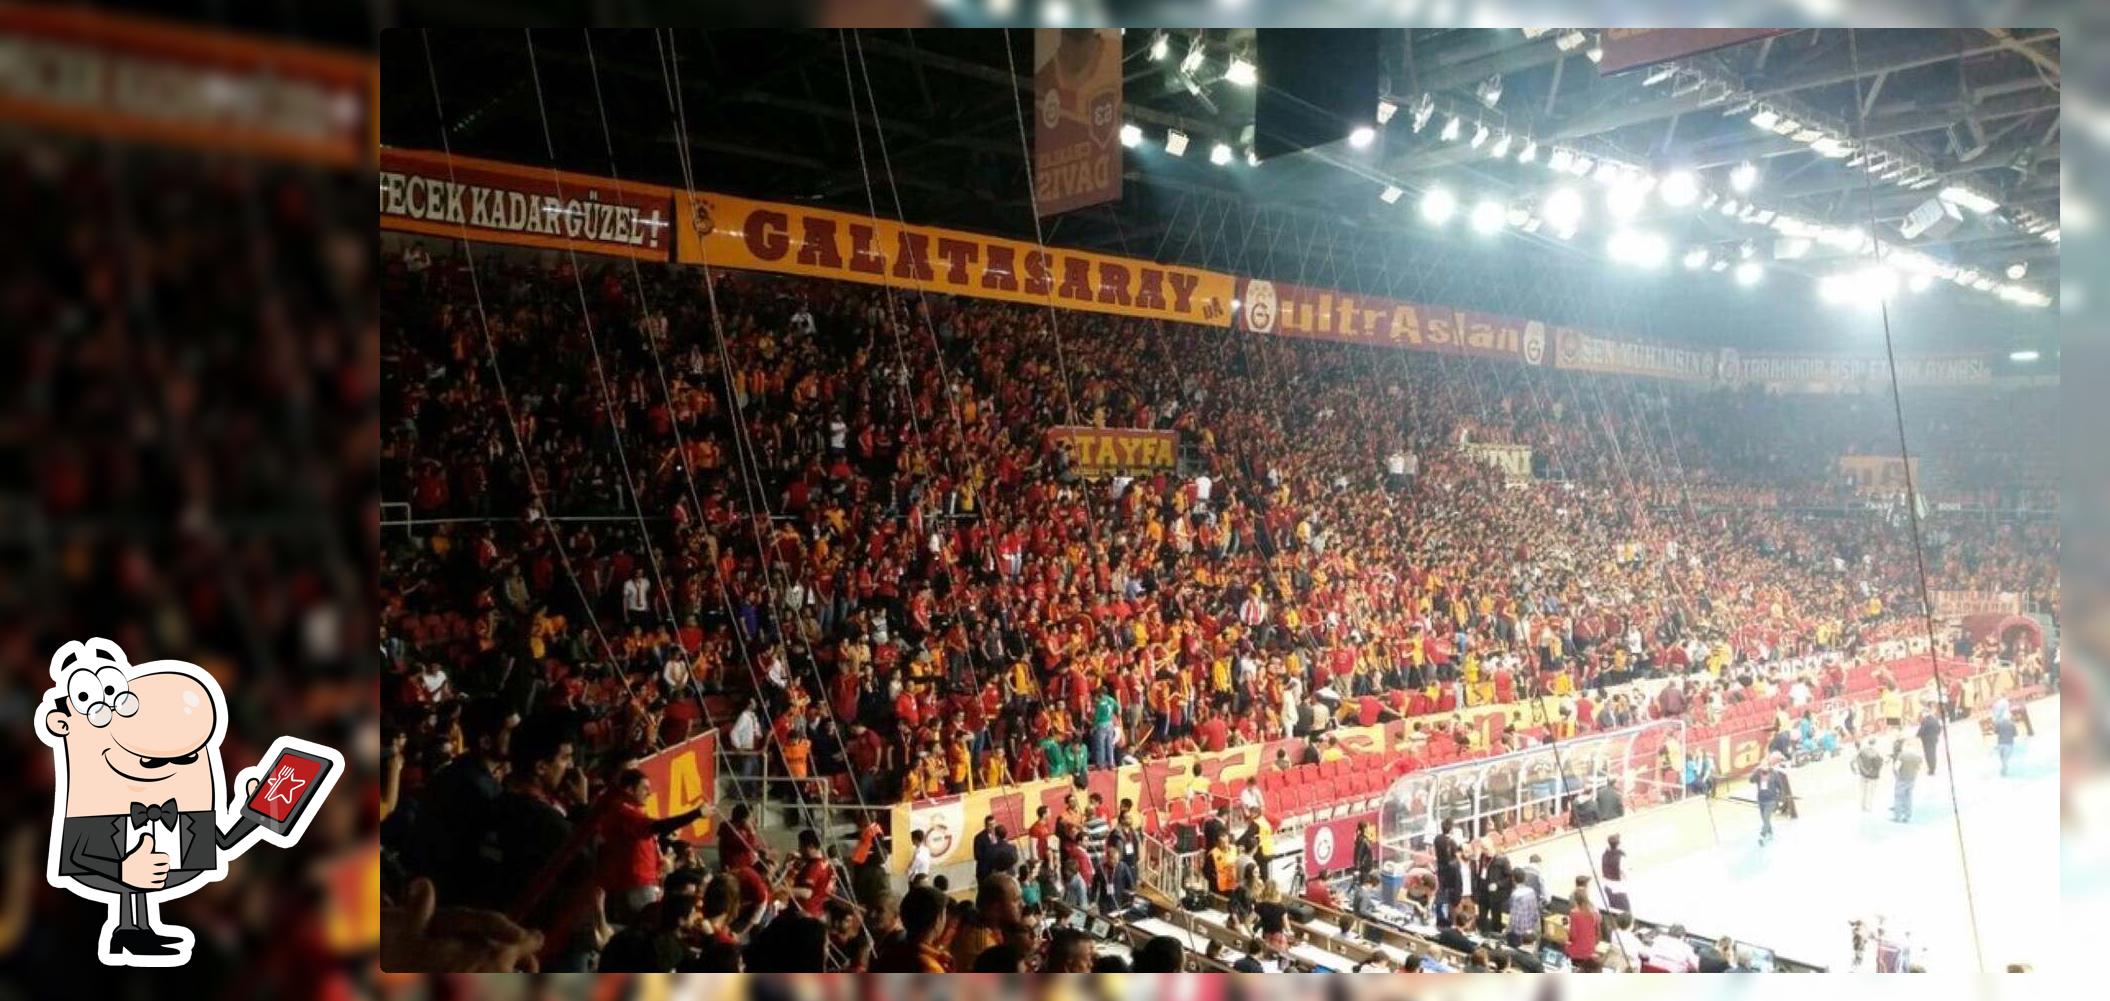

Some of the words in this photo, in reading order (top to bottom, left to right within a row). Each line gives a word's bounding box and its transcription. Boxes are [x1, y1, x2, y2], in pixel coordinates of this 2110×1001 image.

[469, 186, 562, 235] KADAR
[743, 208, 1199, 313] GALATASARAY
[1280, 293, 1519, 353] ultrAslan
[1075, 435, 1173, 466] TAYFA
